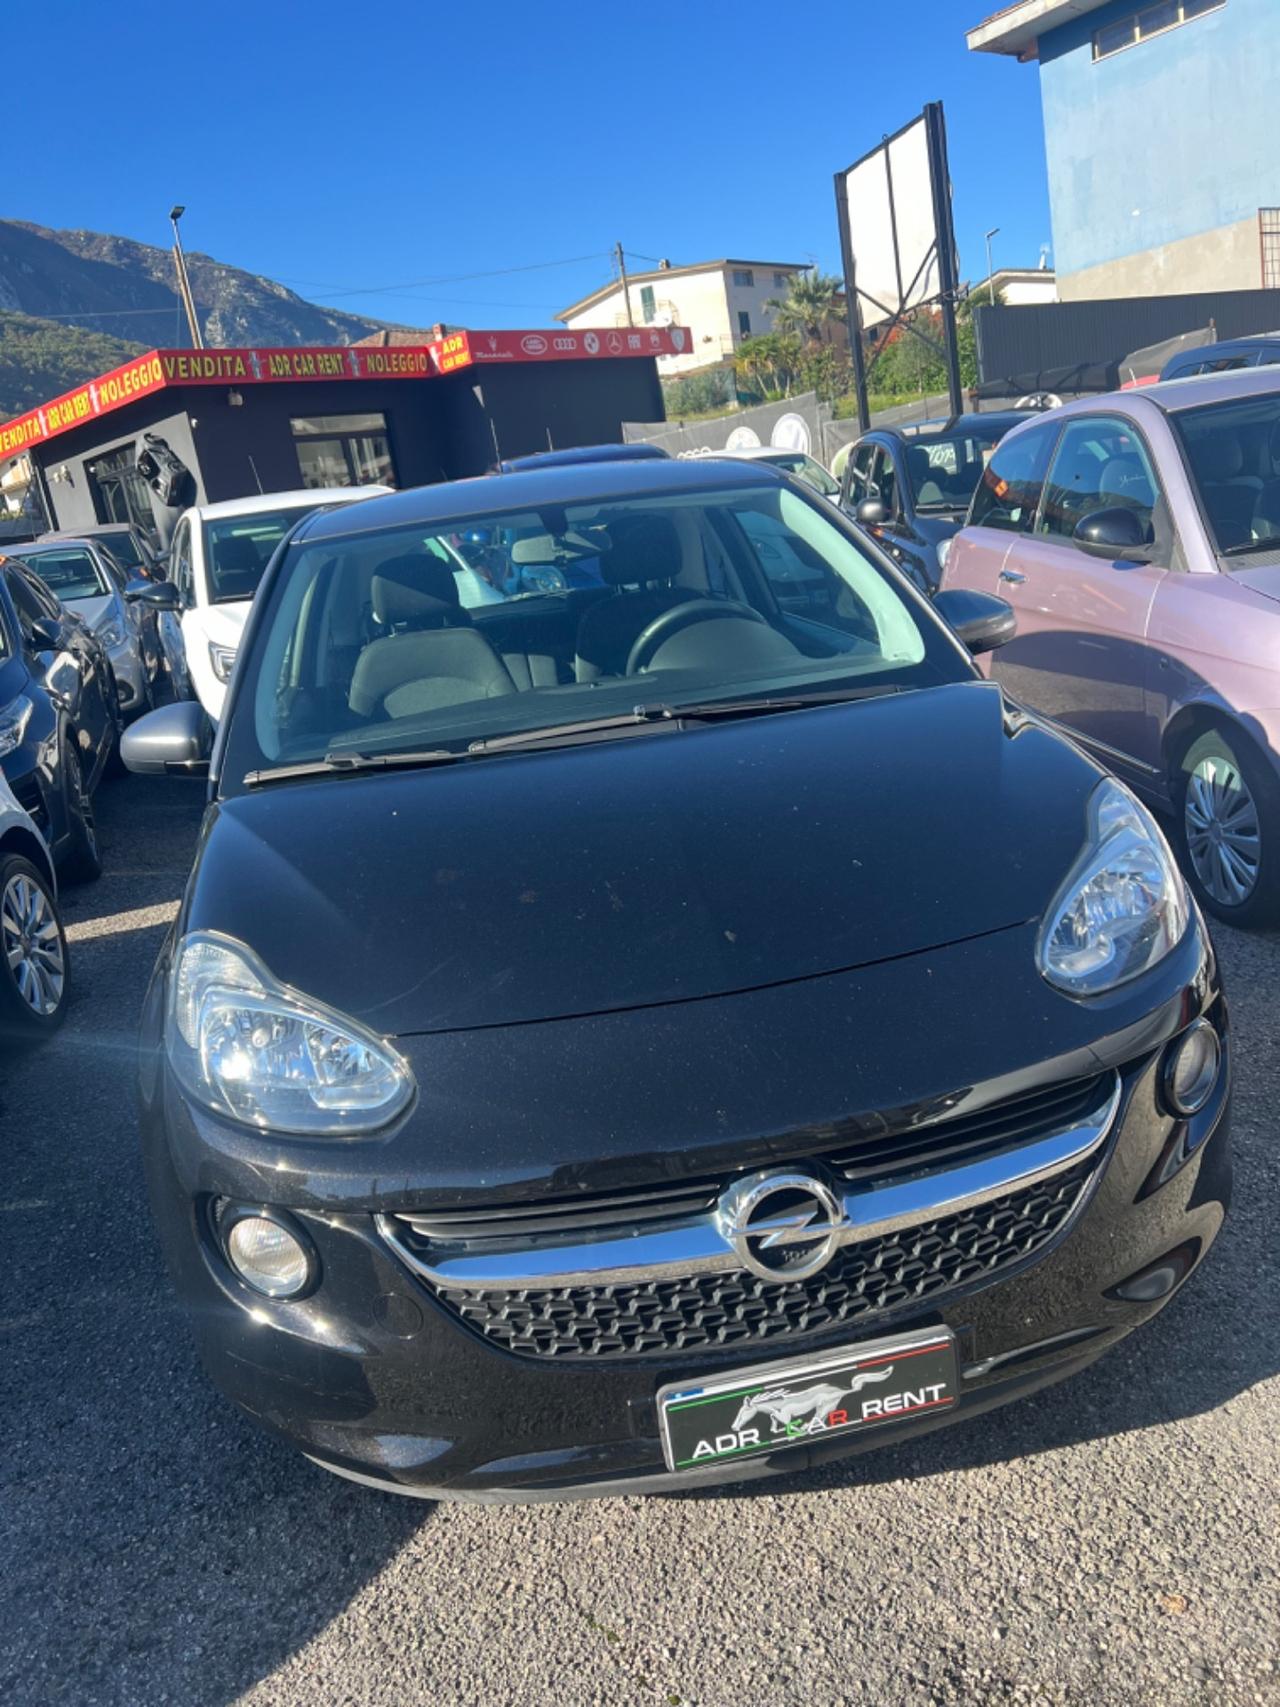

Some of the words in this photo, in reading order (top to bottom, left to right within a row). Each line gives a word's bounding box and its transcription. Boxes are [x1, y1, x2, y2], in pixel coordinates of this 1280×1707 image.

[442, 336, 463, 354] ADR
[164, 356, 246, 378] VENDITA
[269, 354, 292, 376] ADR
[294, 354, 317, 375] CAR
[317, 354, 344, 375] RENT
[367, 354, 427, 372] NOLEGGIO
[99, 357, 162, 406] NOLEGGIO
[692, 1428, 761, 1459] ADR
[786, 1410, 848, 1438] CAR
[861, 1383, 947, 1418] RENT
